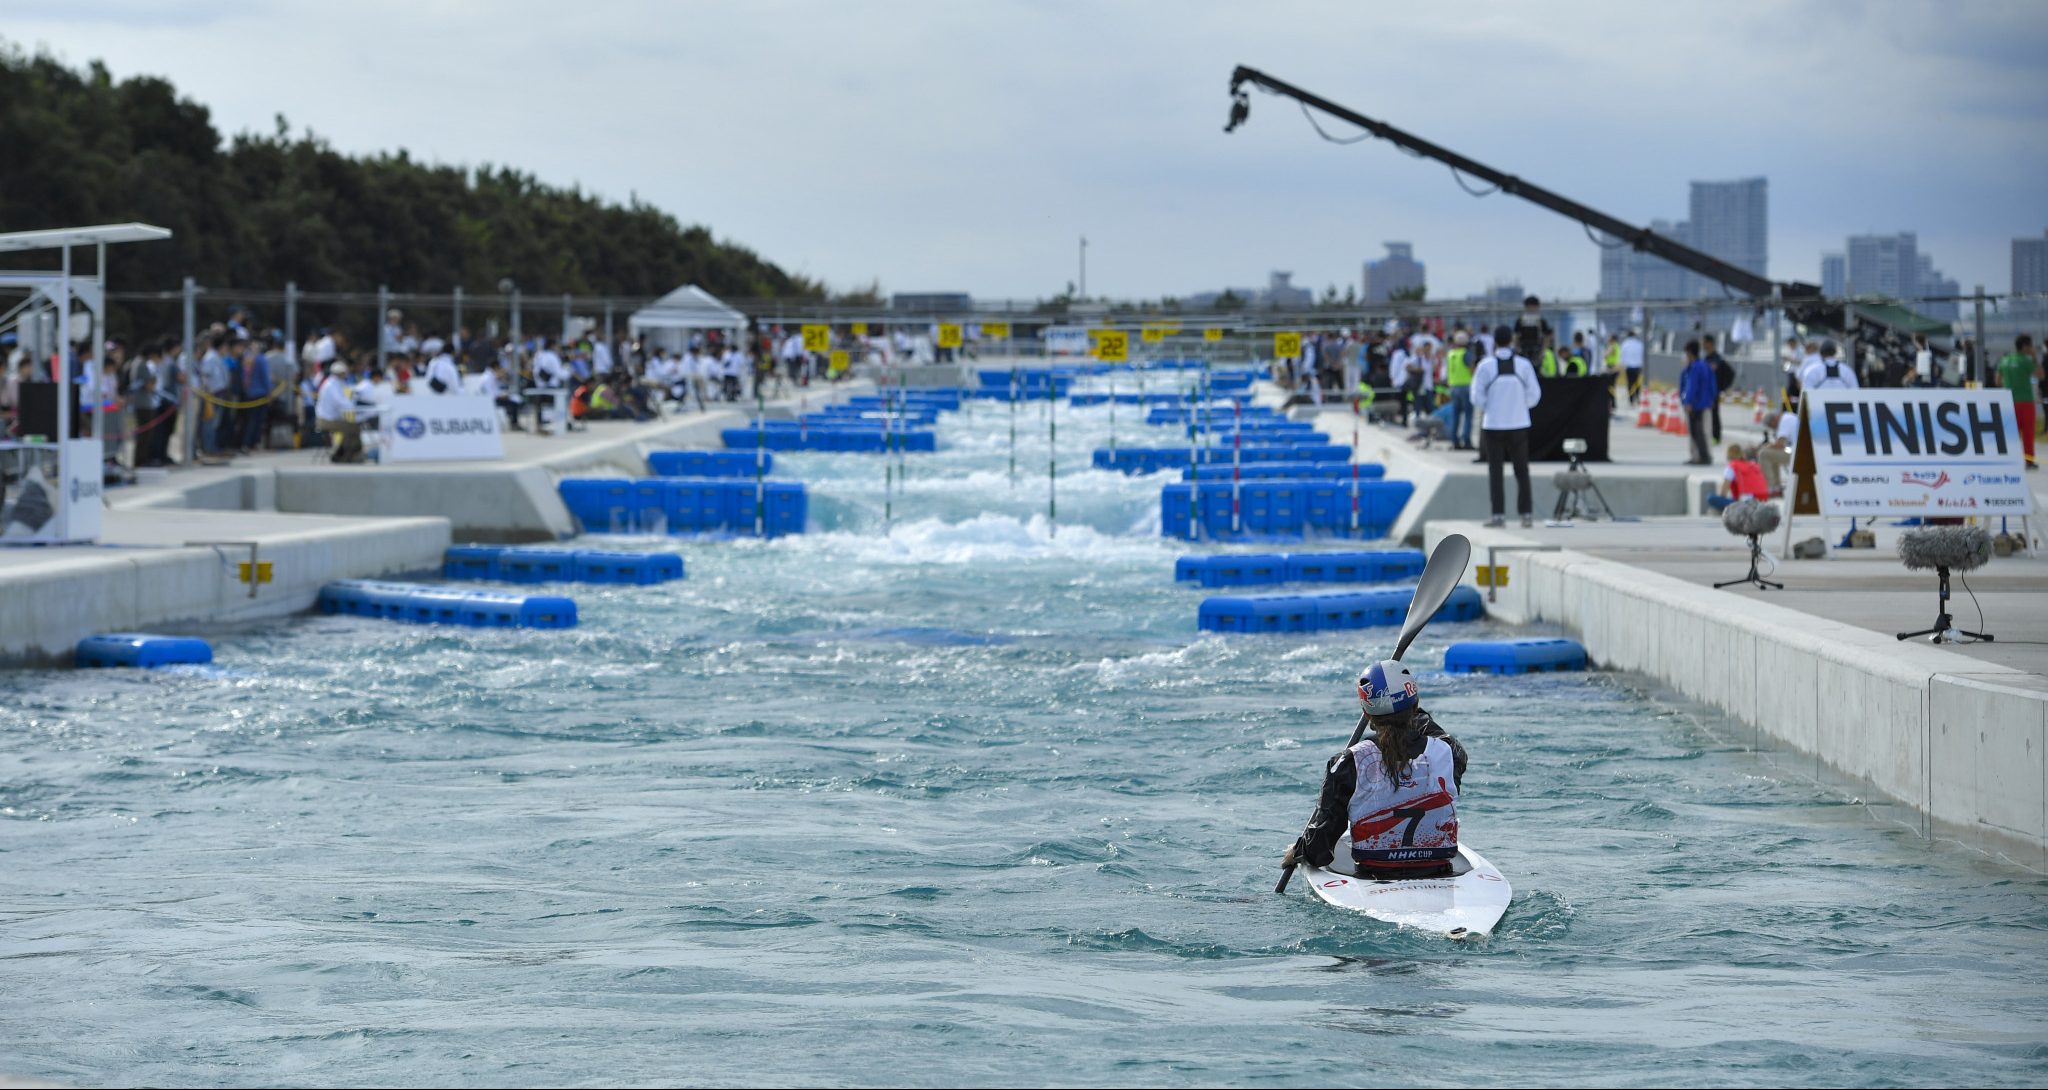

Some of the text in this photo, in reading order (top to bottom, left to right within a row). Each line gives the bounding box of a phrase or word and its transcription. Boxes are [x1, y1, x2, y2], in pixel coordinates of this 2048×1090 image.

[806, 329, 824, 346] 21
[1280, 337, 1298, 354] 20
[1101, 337, 1123, 356] 22
[429, 417, 493, 435] SUBARU
[1825, 402, 2008, 456] FINISH
[1851, 475, 1890, 484] SUBARU
[1394, 808, 1425, 847] 7
[1388, 850, 1433, 859] NHK CUP
